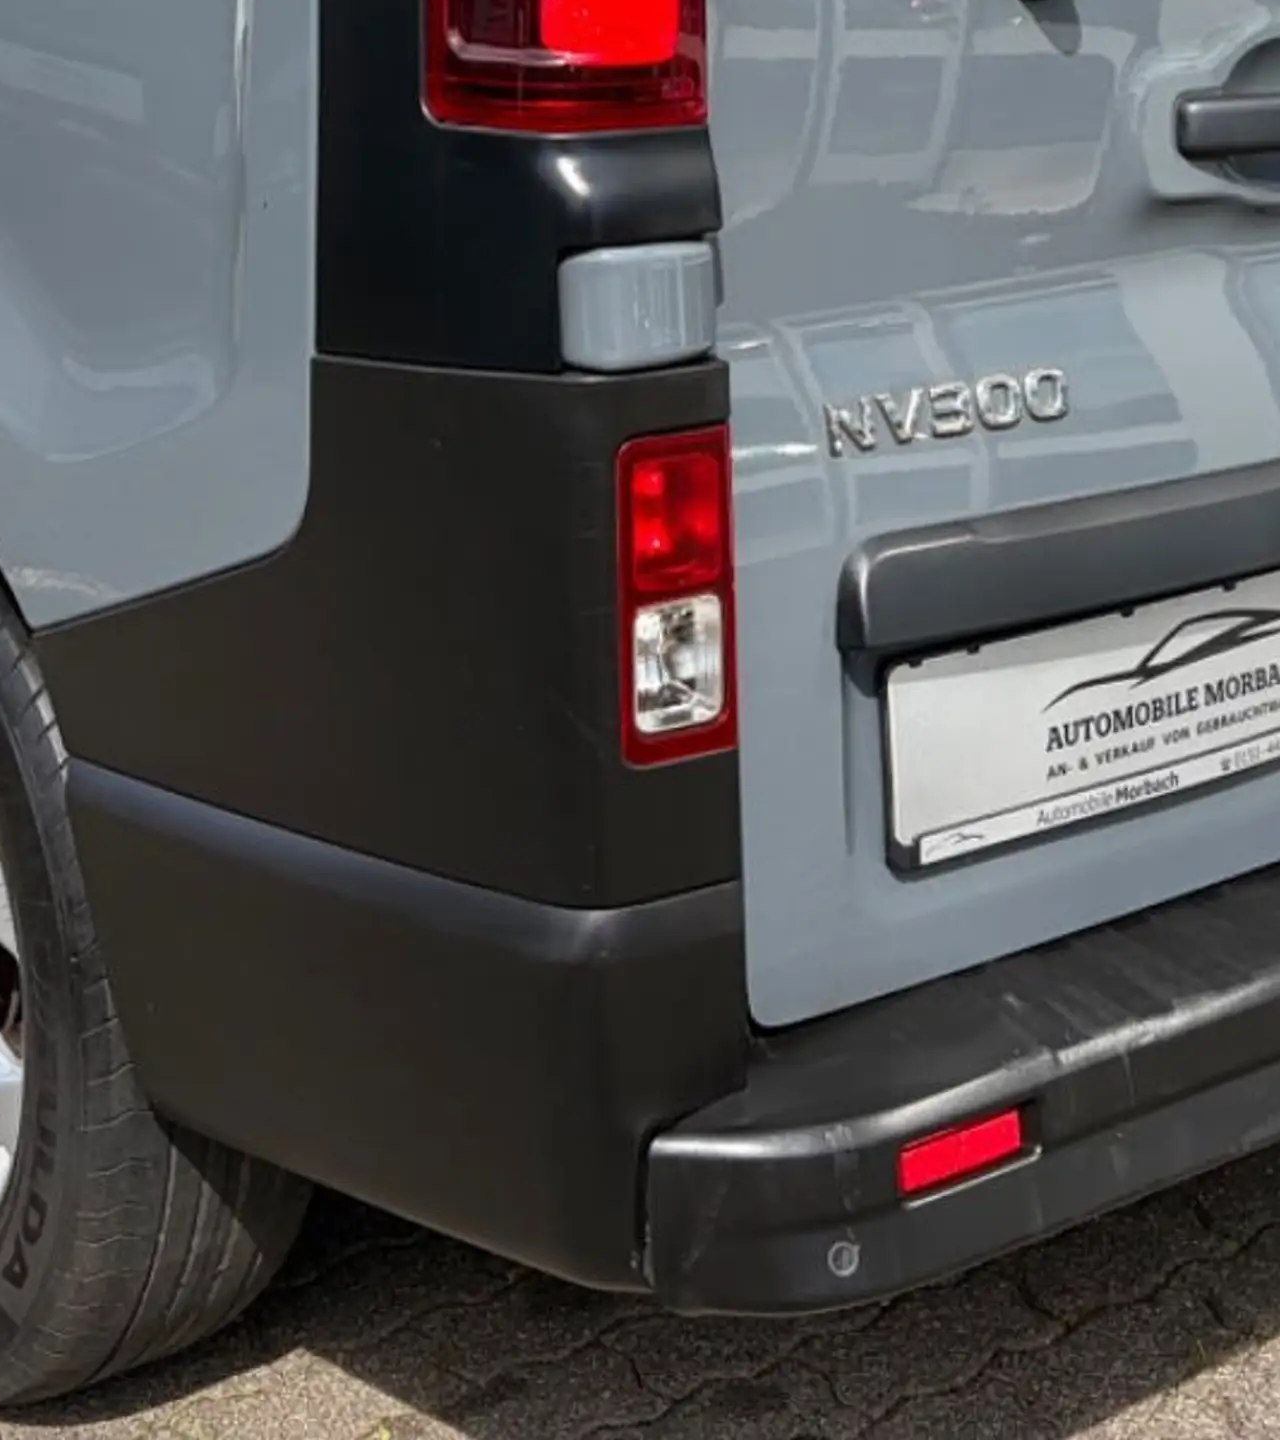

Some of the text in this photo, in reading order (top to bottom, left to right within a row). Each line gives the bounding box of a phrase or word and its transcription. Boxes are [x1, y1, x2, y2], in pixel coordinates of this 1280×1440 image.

[822, 367, 1069, 458] NV300
[1045, 686, 1199, 753] AUTOMOBILE
[1094, 736, 1156, 765] VERKAUF
[1162, 726, 1191, 746] VON
